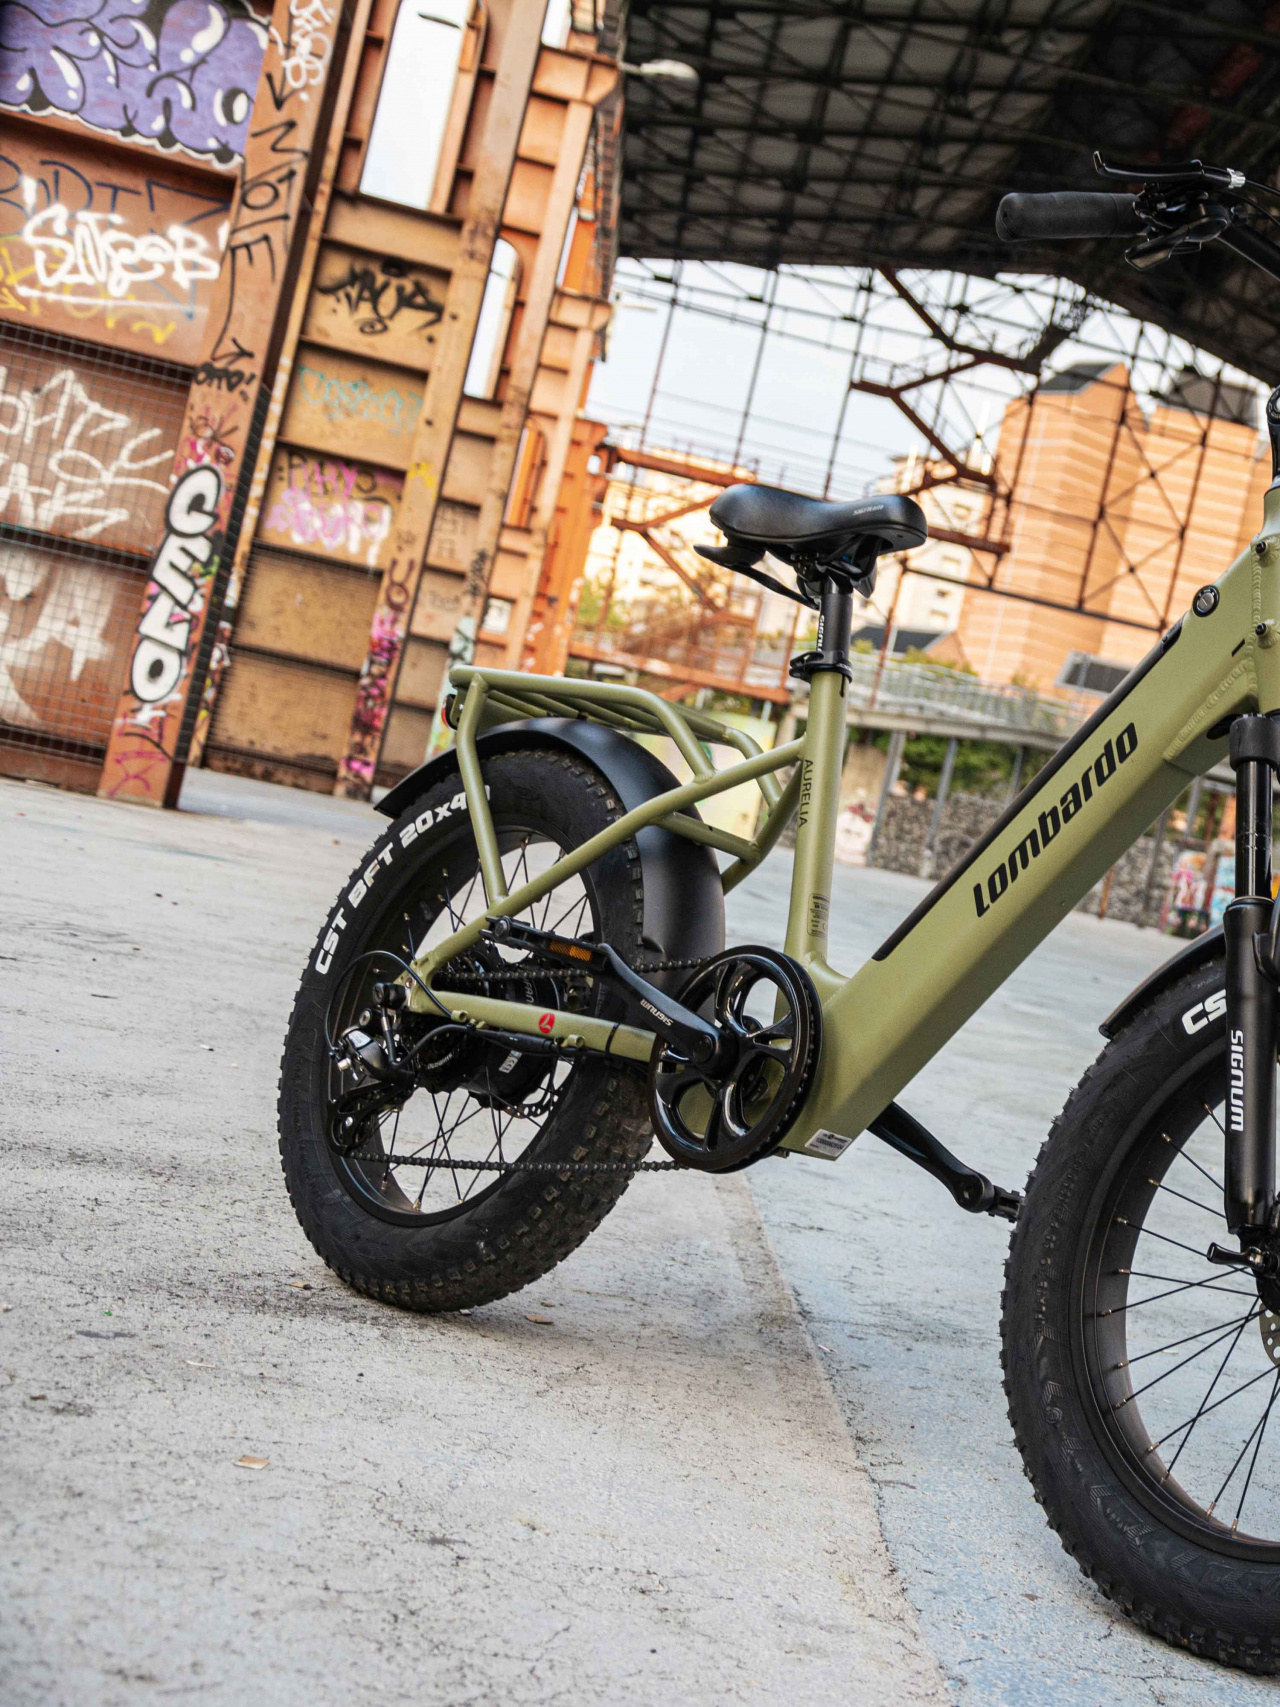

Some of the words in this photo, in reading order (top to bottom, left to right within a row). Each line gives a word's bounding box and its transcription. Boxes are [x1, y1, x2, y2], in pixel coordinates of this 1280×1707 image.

[816, 614, 825, 651] SIGNU
[798, 759, 814, 828] AURELIA
[315, 907, 347, 975] CST
[347, 842, 394, 909] BFT
[398, 784, 491, 848] 20x4
[639, 998, 674, 1027] SIGNUM
[1181, 988, 1227, 1035] CS
[1230, 1029, 1244, 1132] SIGNUM
